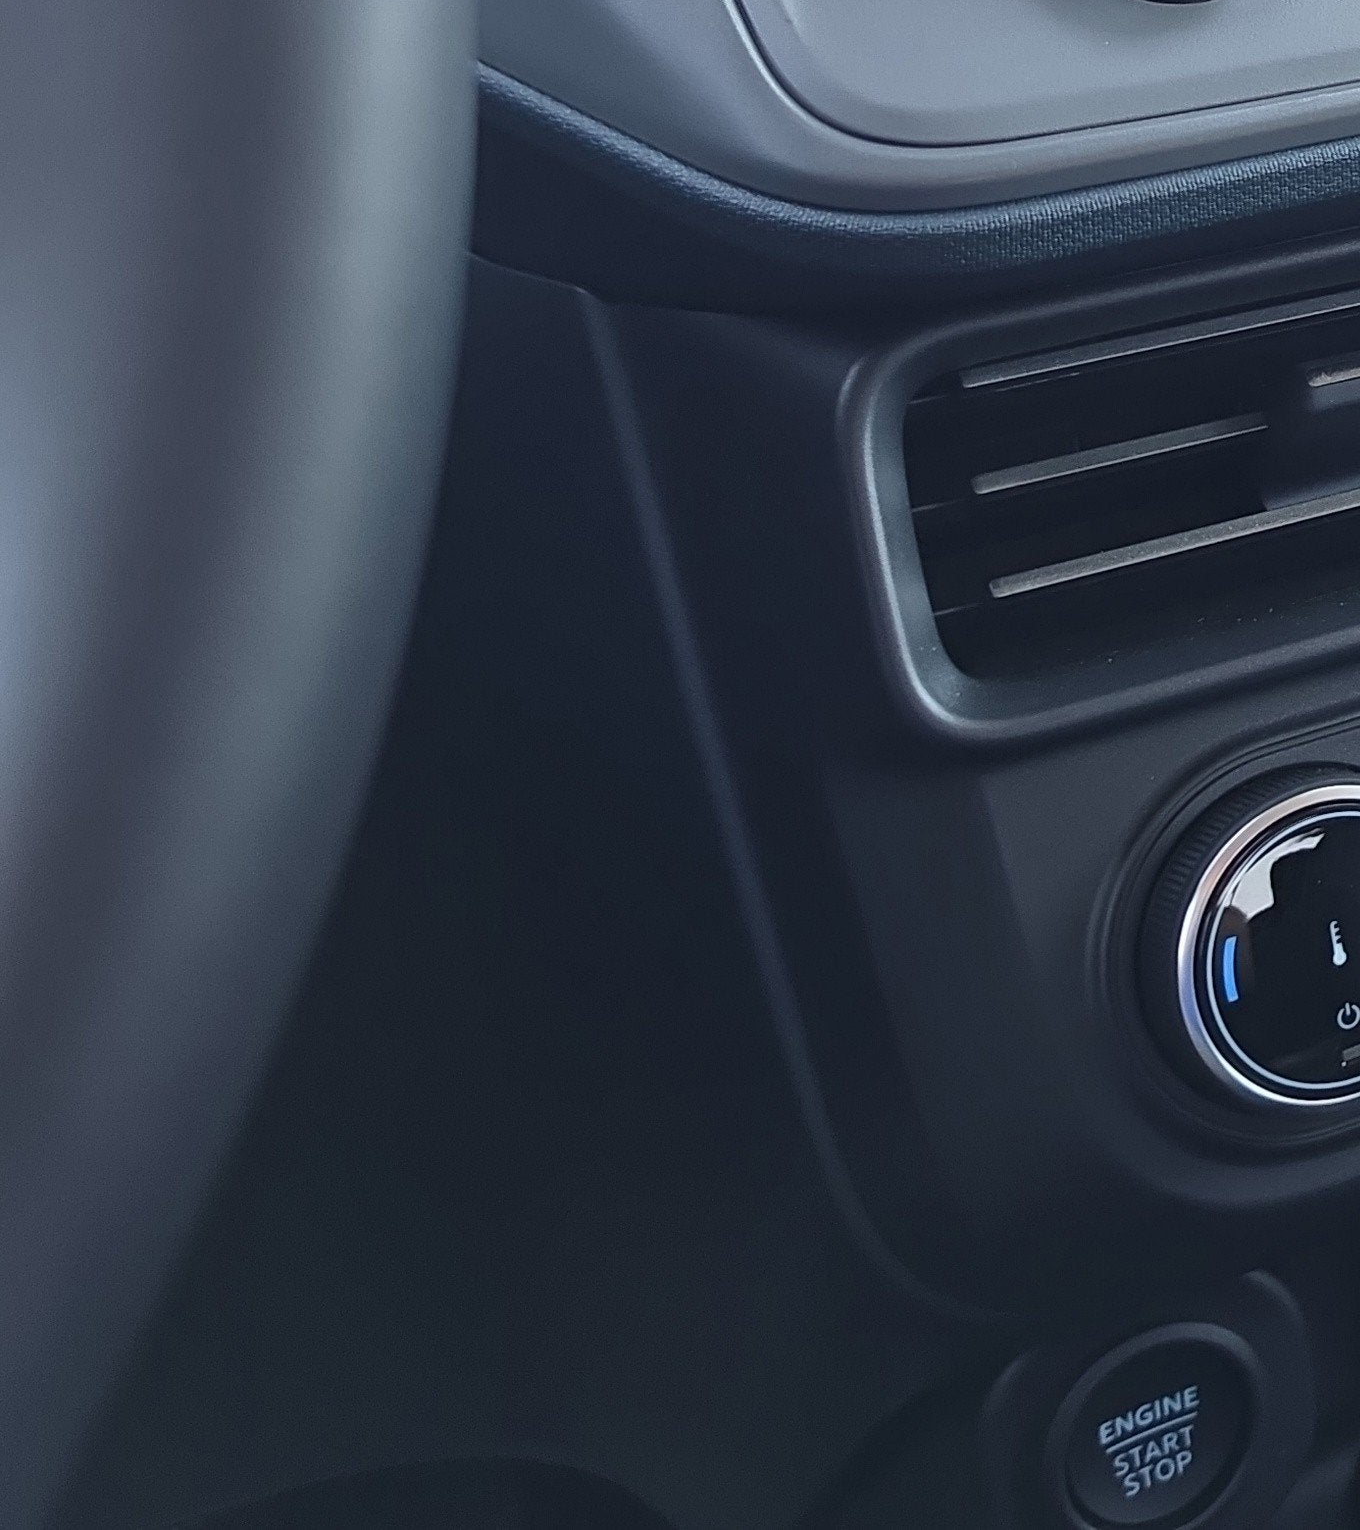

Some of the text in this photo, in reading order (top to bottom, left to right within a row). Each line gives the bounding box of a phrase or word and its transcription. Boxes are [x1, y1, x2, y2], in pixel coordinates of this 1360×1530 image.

[1098, 1385, 1200, 1446] ENGINE
[1112, 1425, 1194, 1477] START
[1122, 1449, 1193, 1497] STOP
